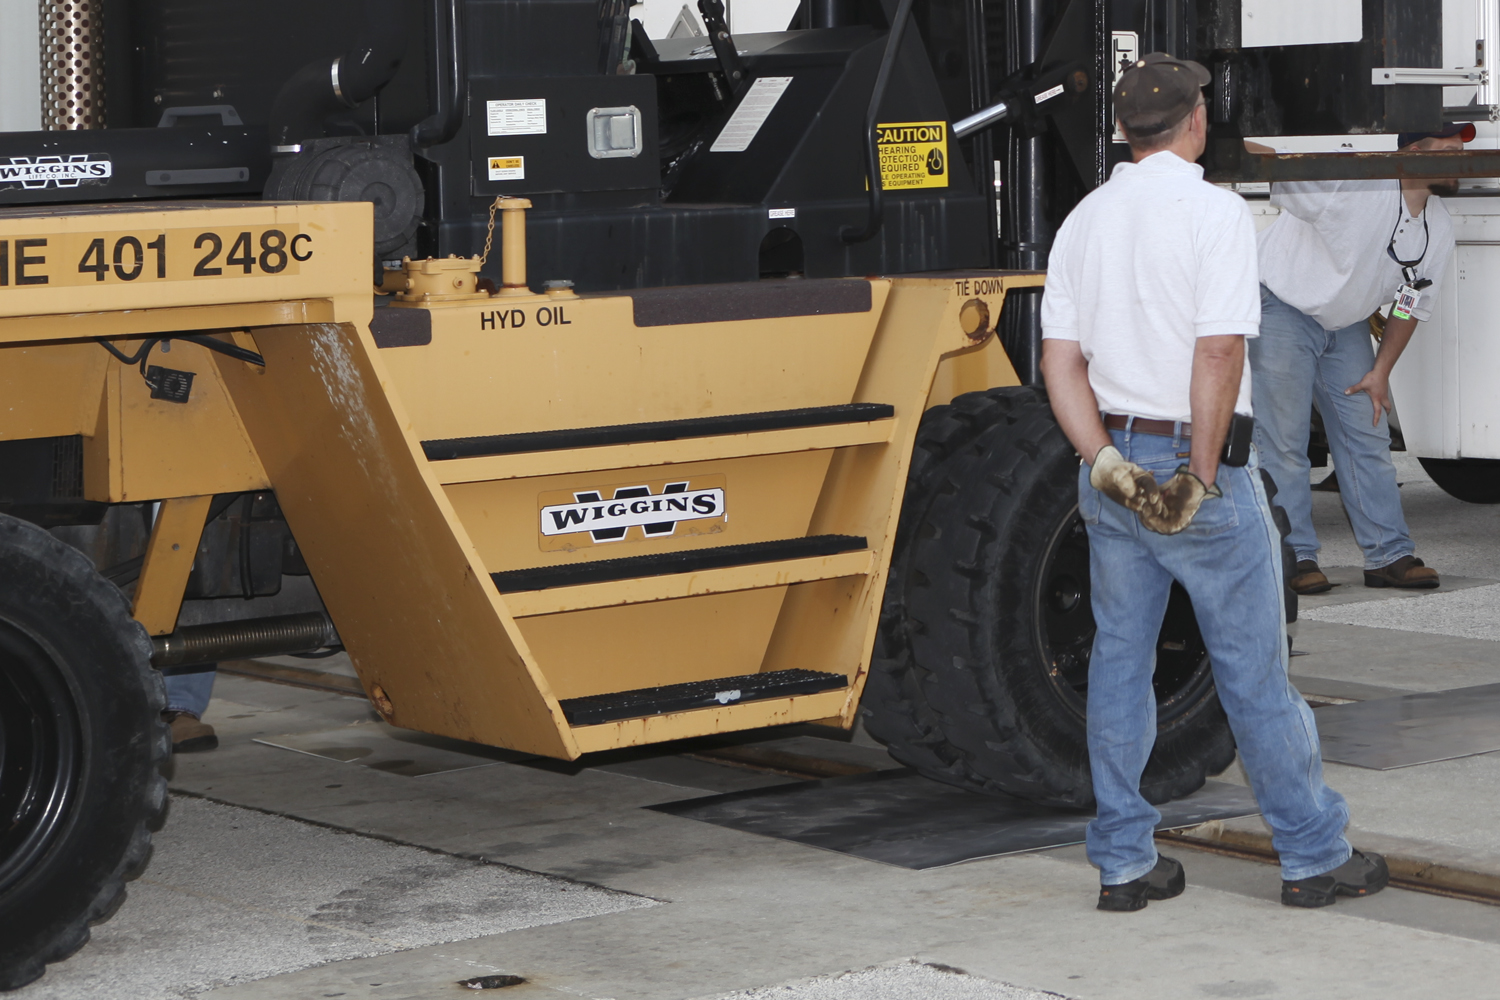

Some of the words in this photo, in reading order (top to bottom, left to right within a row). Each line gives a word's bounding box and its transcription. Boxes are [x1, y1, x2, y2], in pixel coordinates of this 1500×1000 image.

[876, 127, 941, 143] CAUTION
[879, 146, 916, 155] HEARING
[880, 154, 925, 164] OTECTION
[0, 164, 106, 179] WIGGINS
[881, 163, 919, 172] EQUIRED
[0, 238, 49, 286] E
[77, 233, 166, 282] 401
[955, 280, 970, 296] TIE
[974, 279, 1003, 295] DOWN
[480, 308, 526, 330] HYD
[535, 306, 572, 326] OIL
[549, 492, 717, 531] WIGGINS
